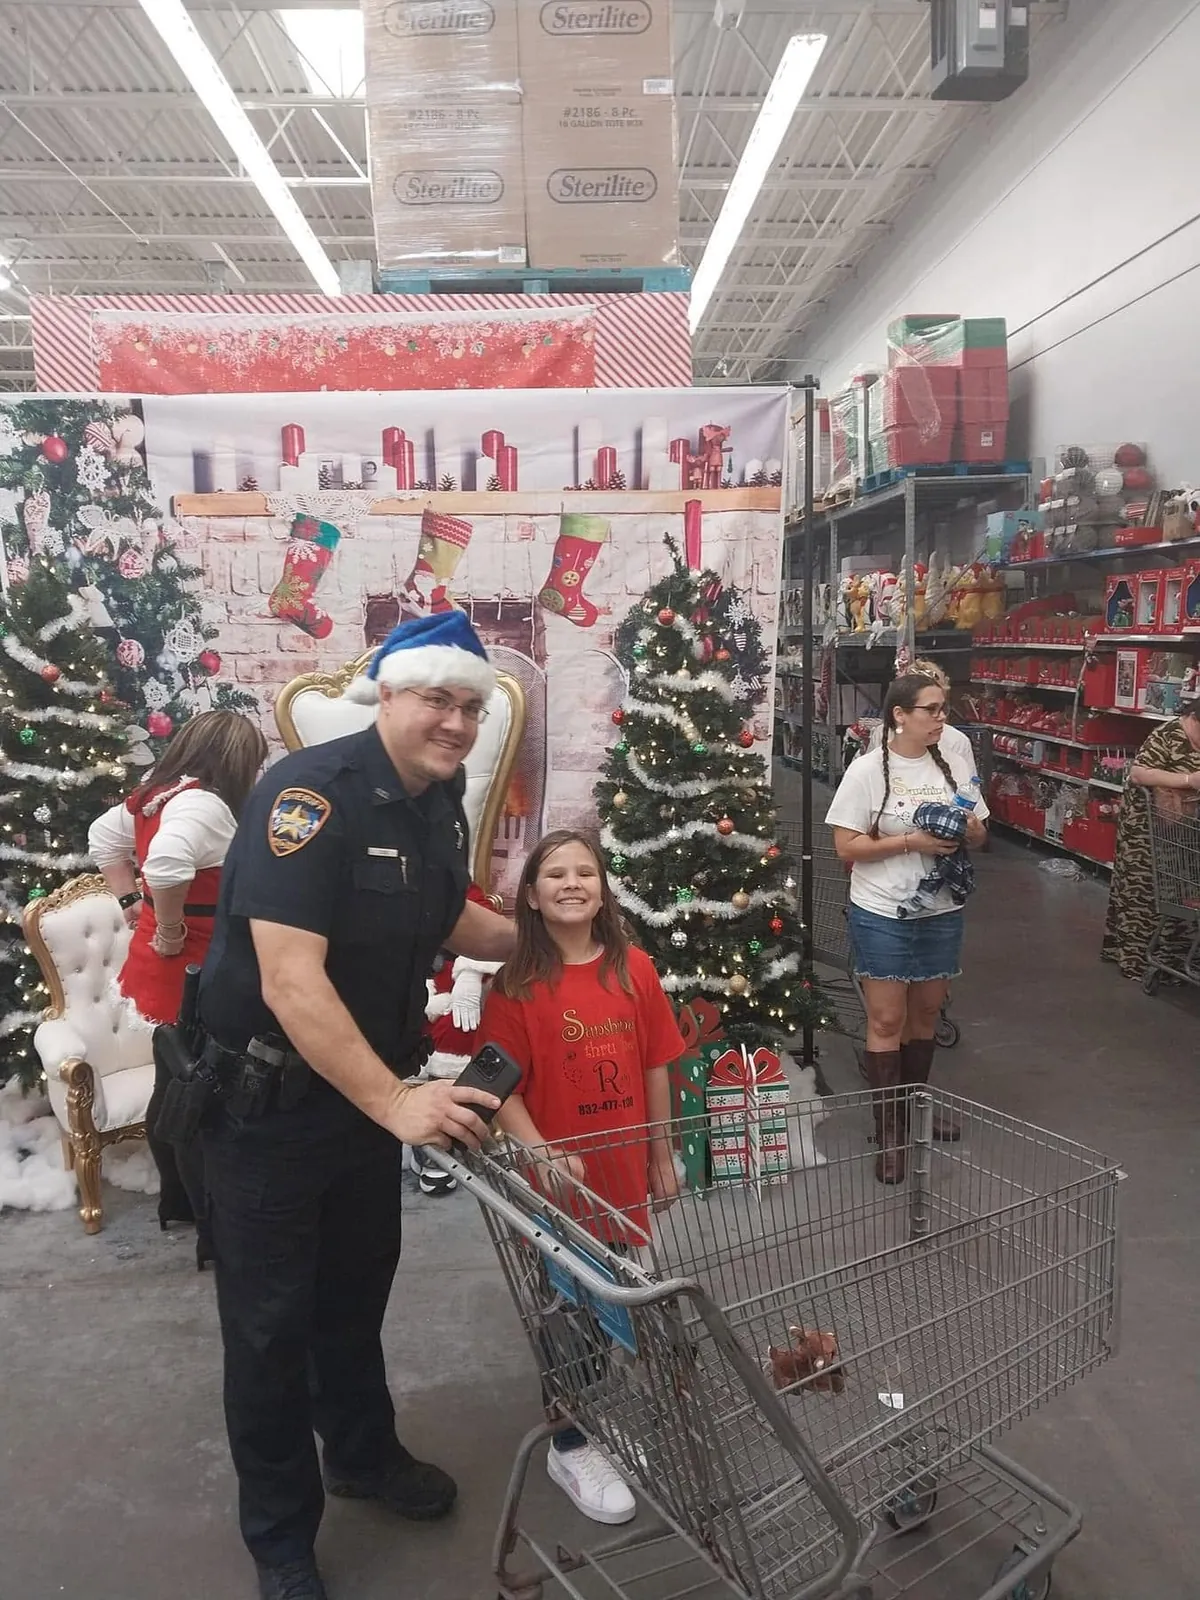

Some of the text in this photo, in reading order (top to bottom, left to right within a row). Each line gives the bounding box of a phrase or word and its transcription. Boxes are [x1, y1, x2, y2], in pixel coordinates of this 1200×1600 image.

[396, 7, 483, 30] Sterilite
[553, 6, 639, 29] Sterilite
[563, 107, 601, 118] #2186
[570, 120, 602, 128] GALLON
[405, 176, 492, 199] Sterilite
[559, 174, 645, 198] Sterilite
[584, 1041, 617, 1058] thru
[592, 1059, 626, 1095] R
